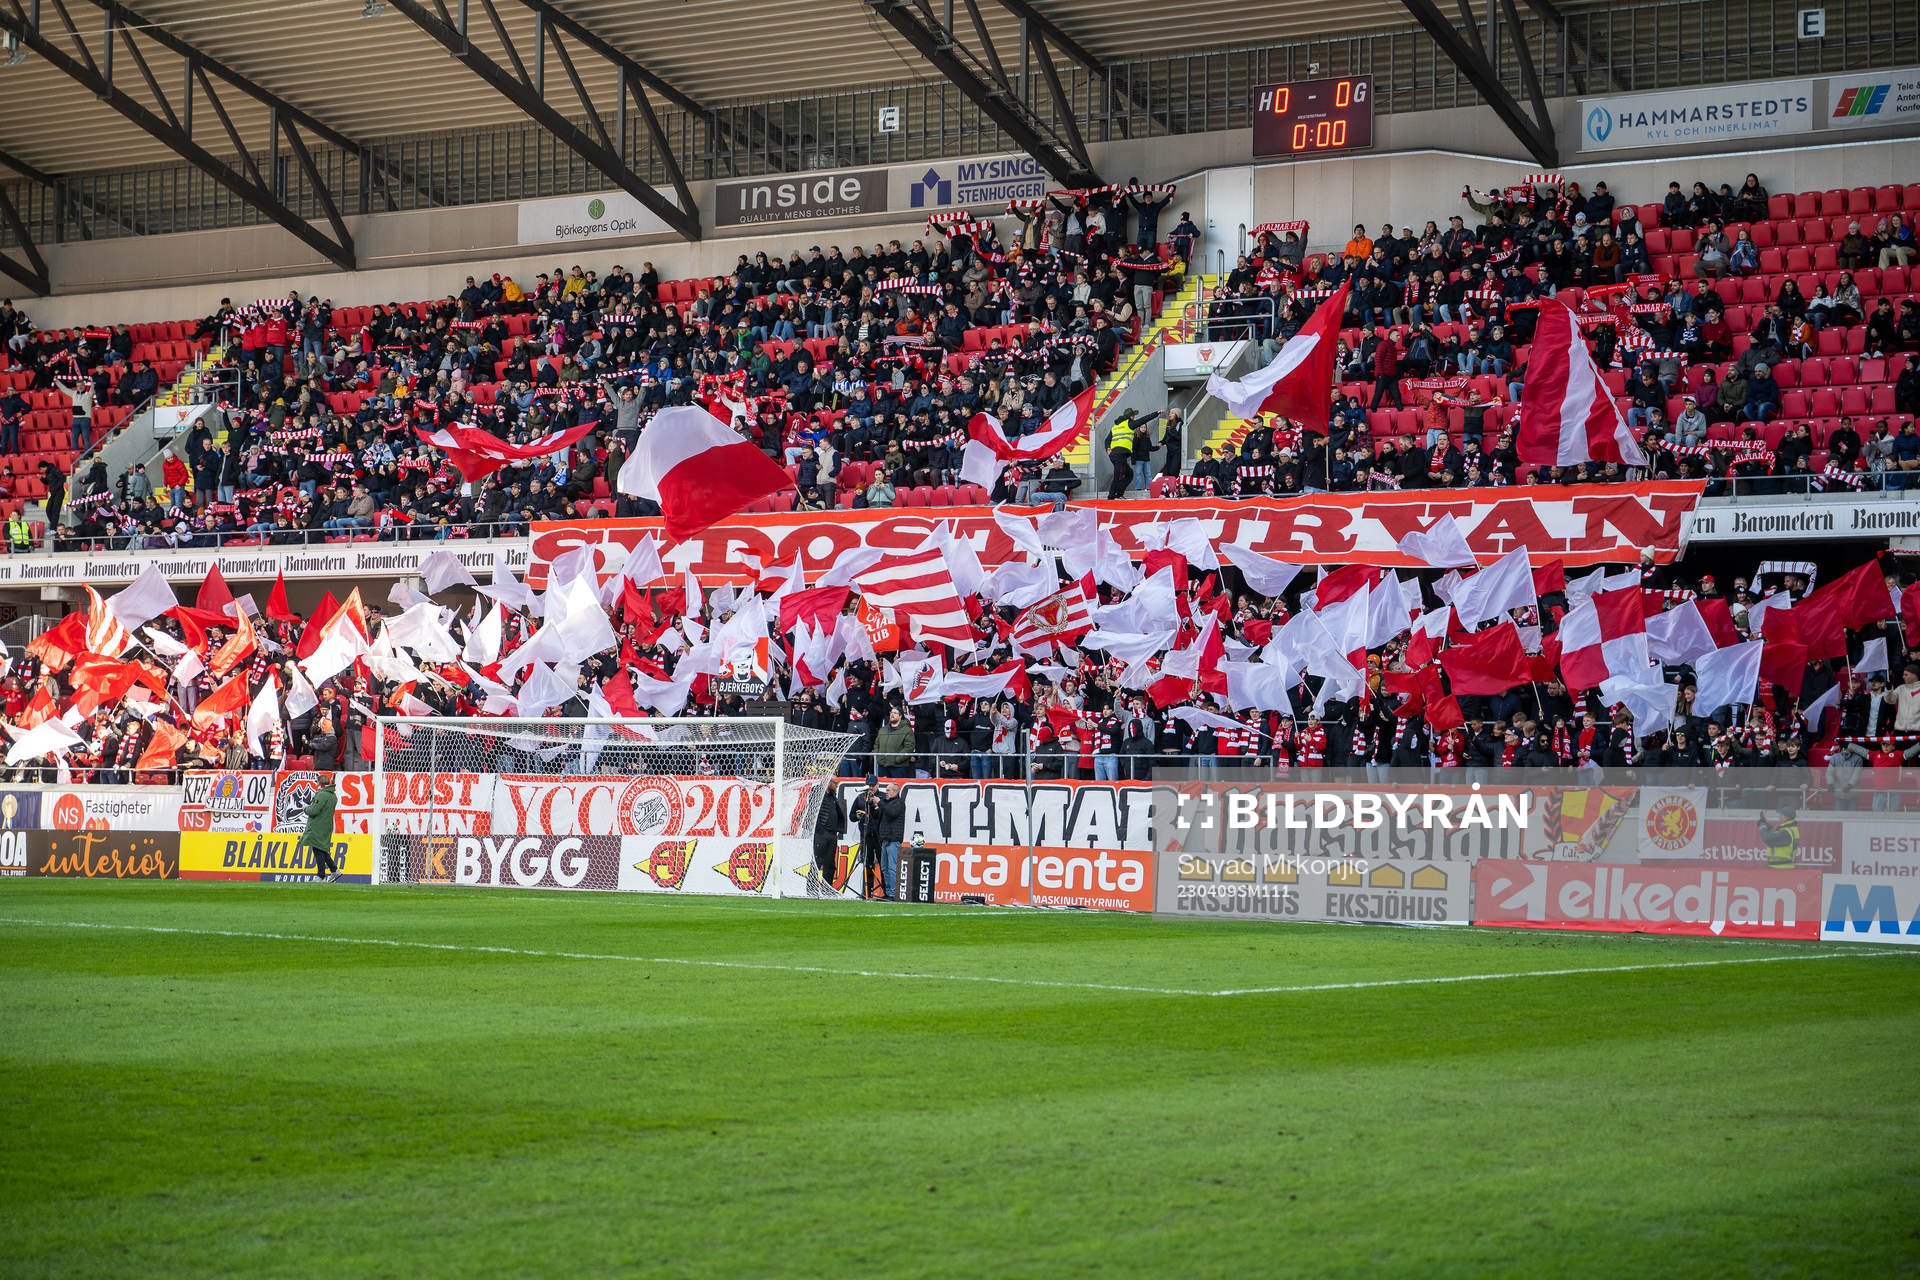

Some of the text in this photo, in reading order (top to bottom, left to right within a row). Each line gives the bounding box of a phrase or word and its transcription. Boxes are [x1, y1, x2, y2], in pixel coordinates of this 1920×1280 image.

[1803, 11, 1820, 36] E
[1258, 91, 1273, 112] H
[1353, 82, 1367, 103] G
[1897, 82, 1914, 91] Tele
[882, 108, 896, 131] E
[1619, 97, 1808, 128] HAMMARSTEDTS
[1293, 120, 1346, 150] 0:00
[1647, 128, 1669, 140] KYL
[1675, 127, 1699, 137] OCH
[957, 182, 1045, 204] STENHUGGERI
[740, 205, 861, 223] QUALITY MENS CLOTHES
[555, 216, 637, 238] Björkegrens Optik
[1260, 223, 1290, 231] KALMAR
[1630, 303, 1661, 313] KALMAR
[1732, 511, 1834, 533] Barometern
[19, 563, 75, 579] Barometern
[83, 560, 140, 577] Barometern
[217, 557, 276, 575] Barometern
[284, 555, 346, 571] Barometern
[354, 553, 419, 570] Barometern
[719, 681, 765, 695] BJERKEBOYS
[184, 777, 211, 804] KFF
[247, 776, 267, 804] 08
[86, 800, 152, 817] Fastigheter
[206, 796, 245, 811] STHLM
[504, 783, 813, 838] YCC 2021
[58, 808, 79, 825] NS
[183, 811, 205, 828] NS
[341, 812, 475, 835] KRVAN
[40, 831, 175, 879] interiör
[1869, 837, 1920, 853] BEST
[455, 836, 589, 888] BYGG
[1021, 851, 1144, 892] renta
[900, 860, 909, 900] SELECT
[920, 860, 930, 901] SELECT
[1032, 894, 1130, 908] MASKINUTHYRNING
[1325, 890, 1448, 922] EKSJÖHUS
[1558, 867, 1797, 935] elkedjan
